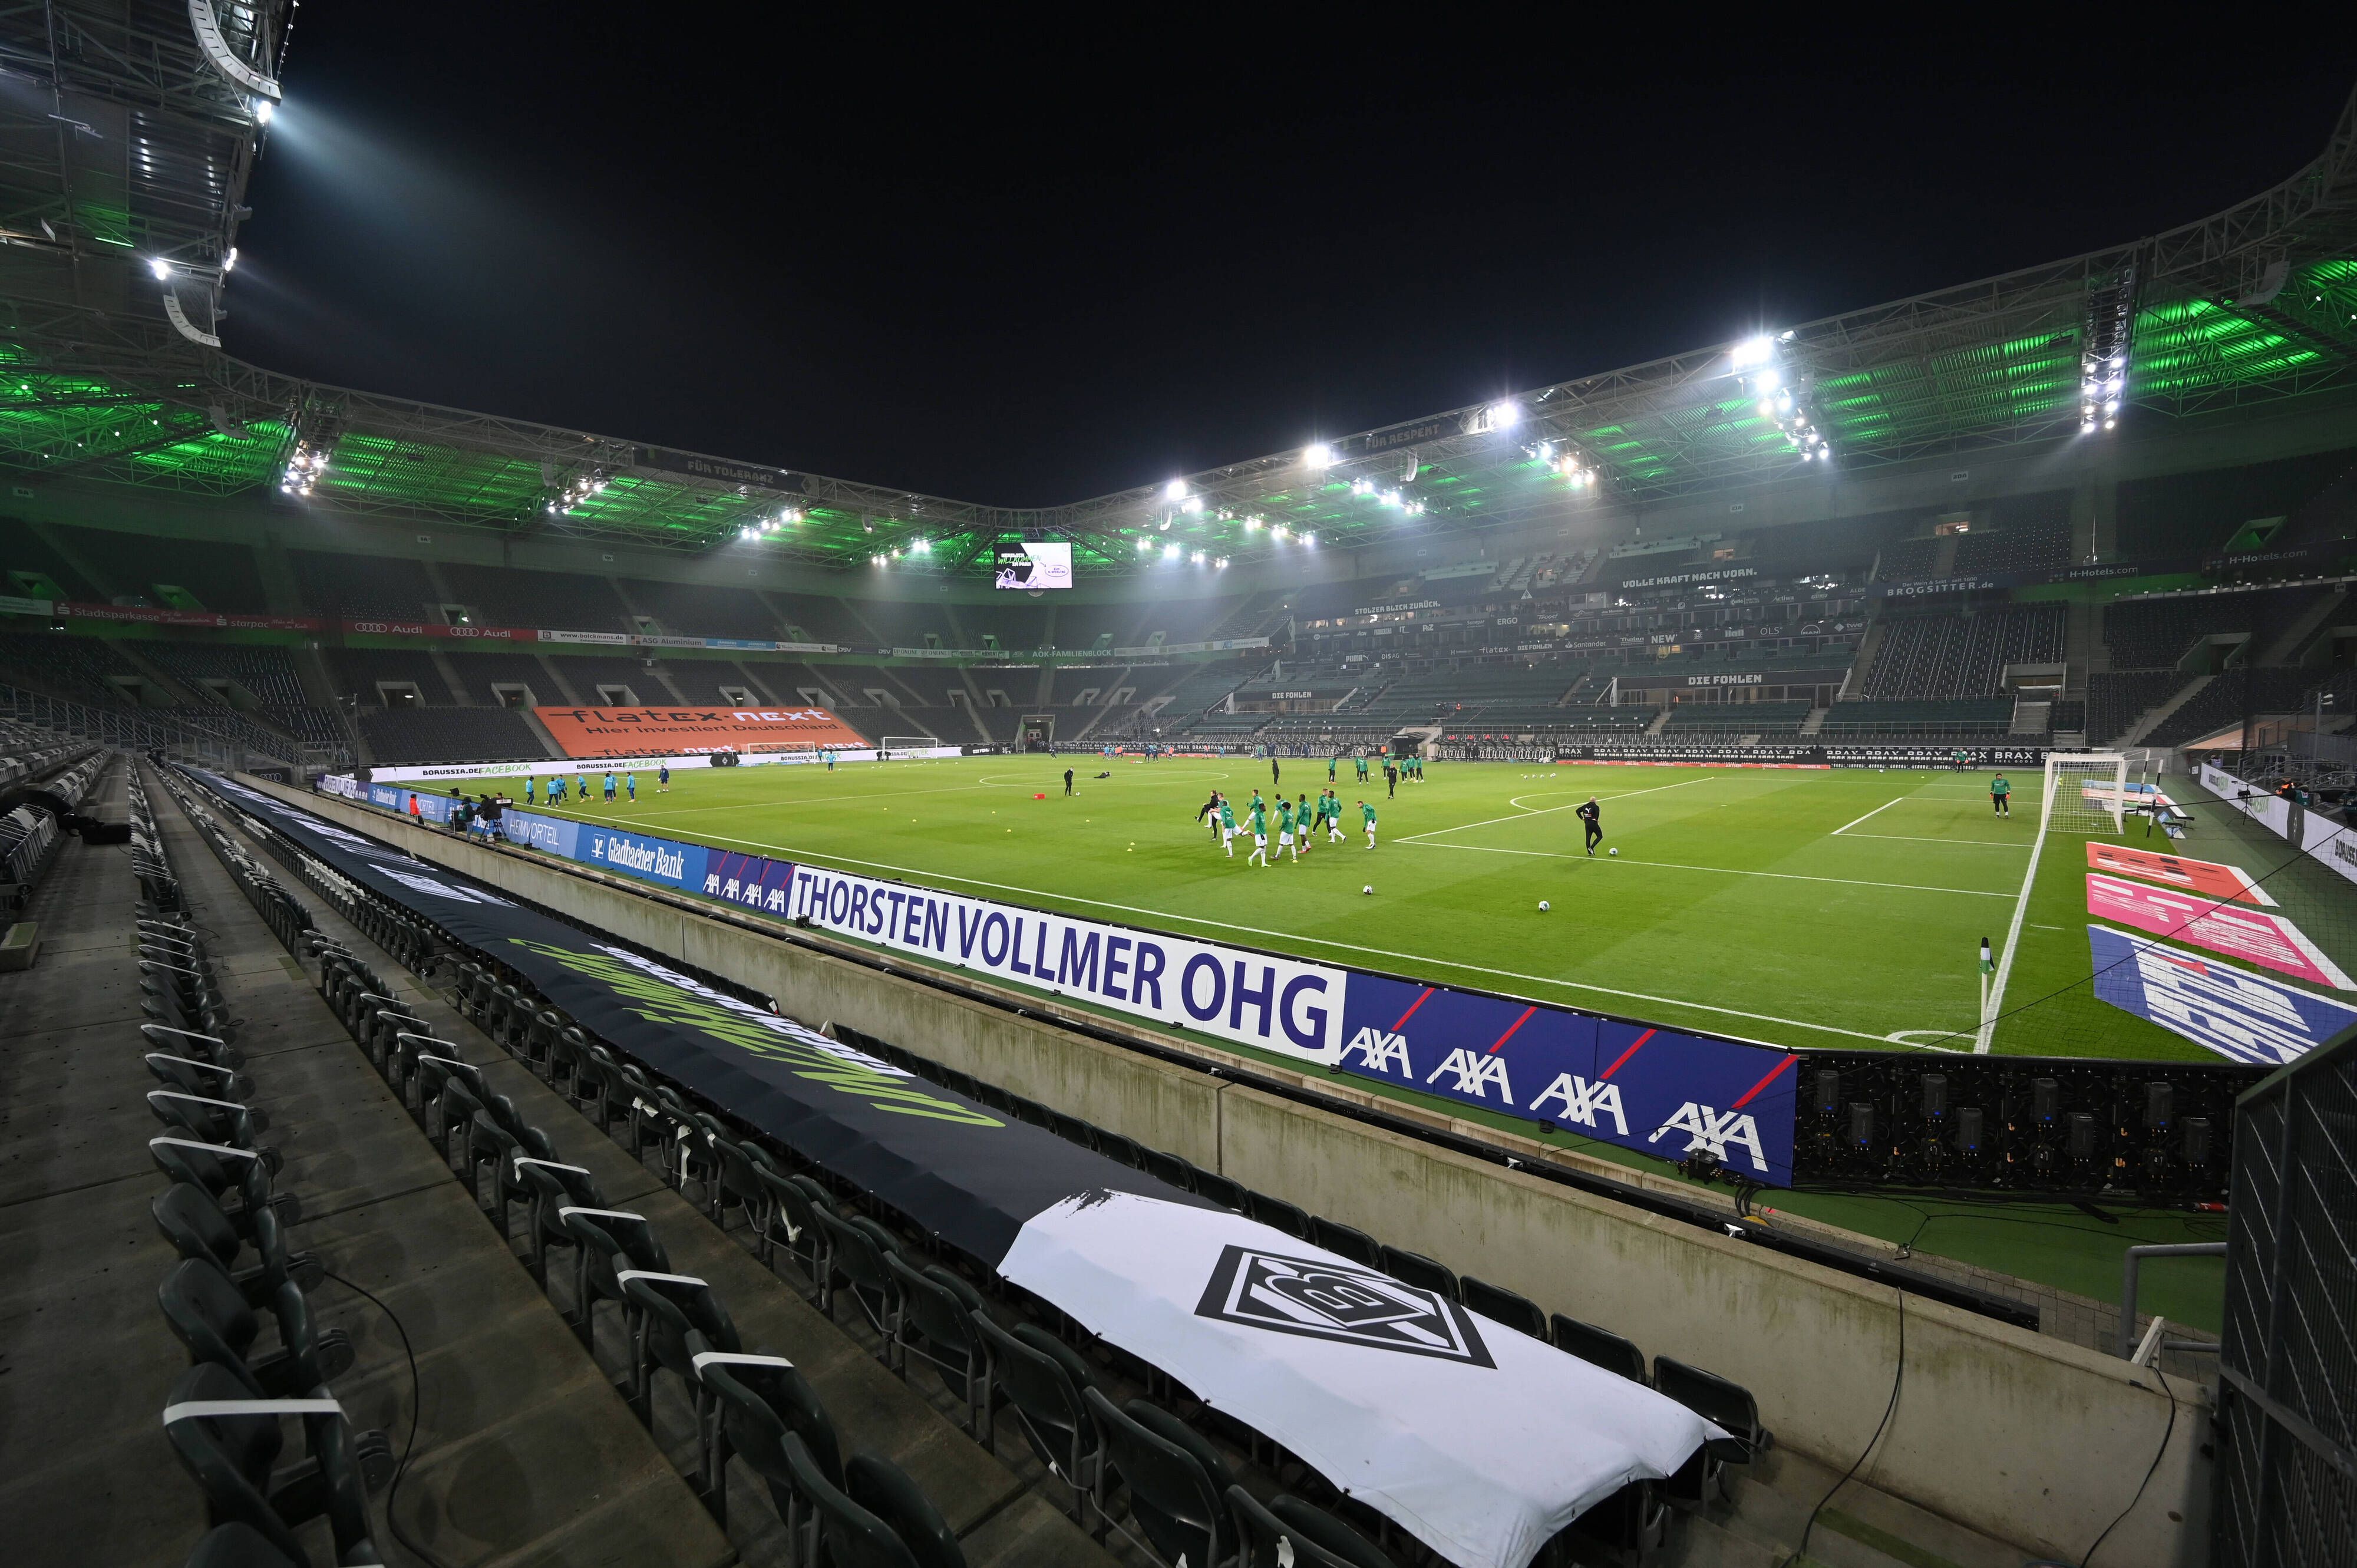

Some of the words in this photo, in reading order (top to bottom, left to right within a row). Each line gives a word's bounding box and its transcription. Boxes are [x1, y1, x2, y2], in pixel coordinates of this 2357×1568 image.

[998, 555, 1041, 565] WILLKOMMEN
[2230, 549, 2308, 565] H-Hotels.com
[1622, 579, 1654, 588] VOLLE
[1657, 575, 1690, 585] KRAFT
[1692, 572, 1720, 581] NACH
[1723, 568, 1757, 578] VORN.
[2069, 566, 2138, 578] H-Hotels.com
[1887, 582, 1994, 596] BROGSITTER.de
[1355, 606, 1384, 615] STOLZER
[1387, 603, 1408, 612] BLICK
[1409, 600, 1441, 609] ZURÜCK.
[75, 608, 160, 622] Stadtsparkasse
[1497, 617, 1518, 625] ERGO
[231, 619, 269, 629] starpac
[392, 625, 422, 634] Audi
[483, 629, 511, 638] Audi
[1688, 676, 1710, 685] DIE
[1713, 674, 1762, 684] FOHLEN
[637, 725, 728, 733] investiert
[732, 723, 843, 732] Deutschland.
[509, 818, 559, 846] HEIMVORTEIL
[608, 836, 656, 873] Gladbacher
[654, 847, 685, 880] Bank
[703, 873, 719, 895] AXA
[721, 878, 740, 900] AXA
[741, 883, 762, 906] AXA
[764, 888, 785, 913] AXA
[797, 873, 949, 952] THORSTEN
[957, 903, 1163, 1011] VOLLMER
[1181, 952, 1329, 1051] OHG
[1340, 1026, 1413, 1079] AXA
[1426, 1048, 1514, 1105] AXA
[1530, 1072, 1630, 1137] AXA
[1648, 1101, 1769, 1172] AXA
